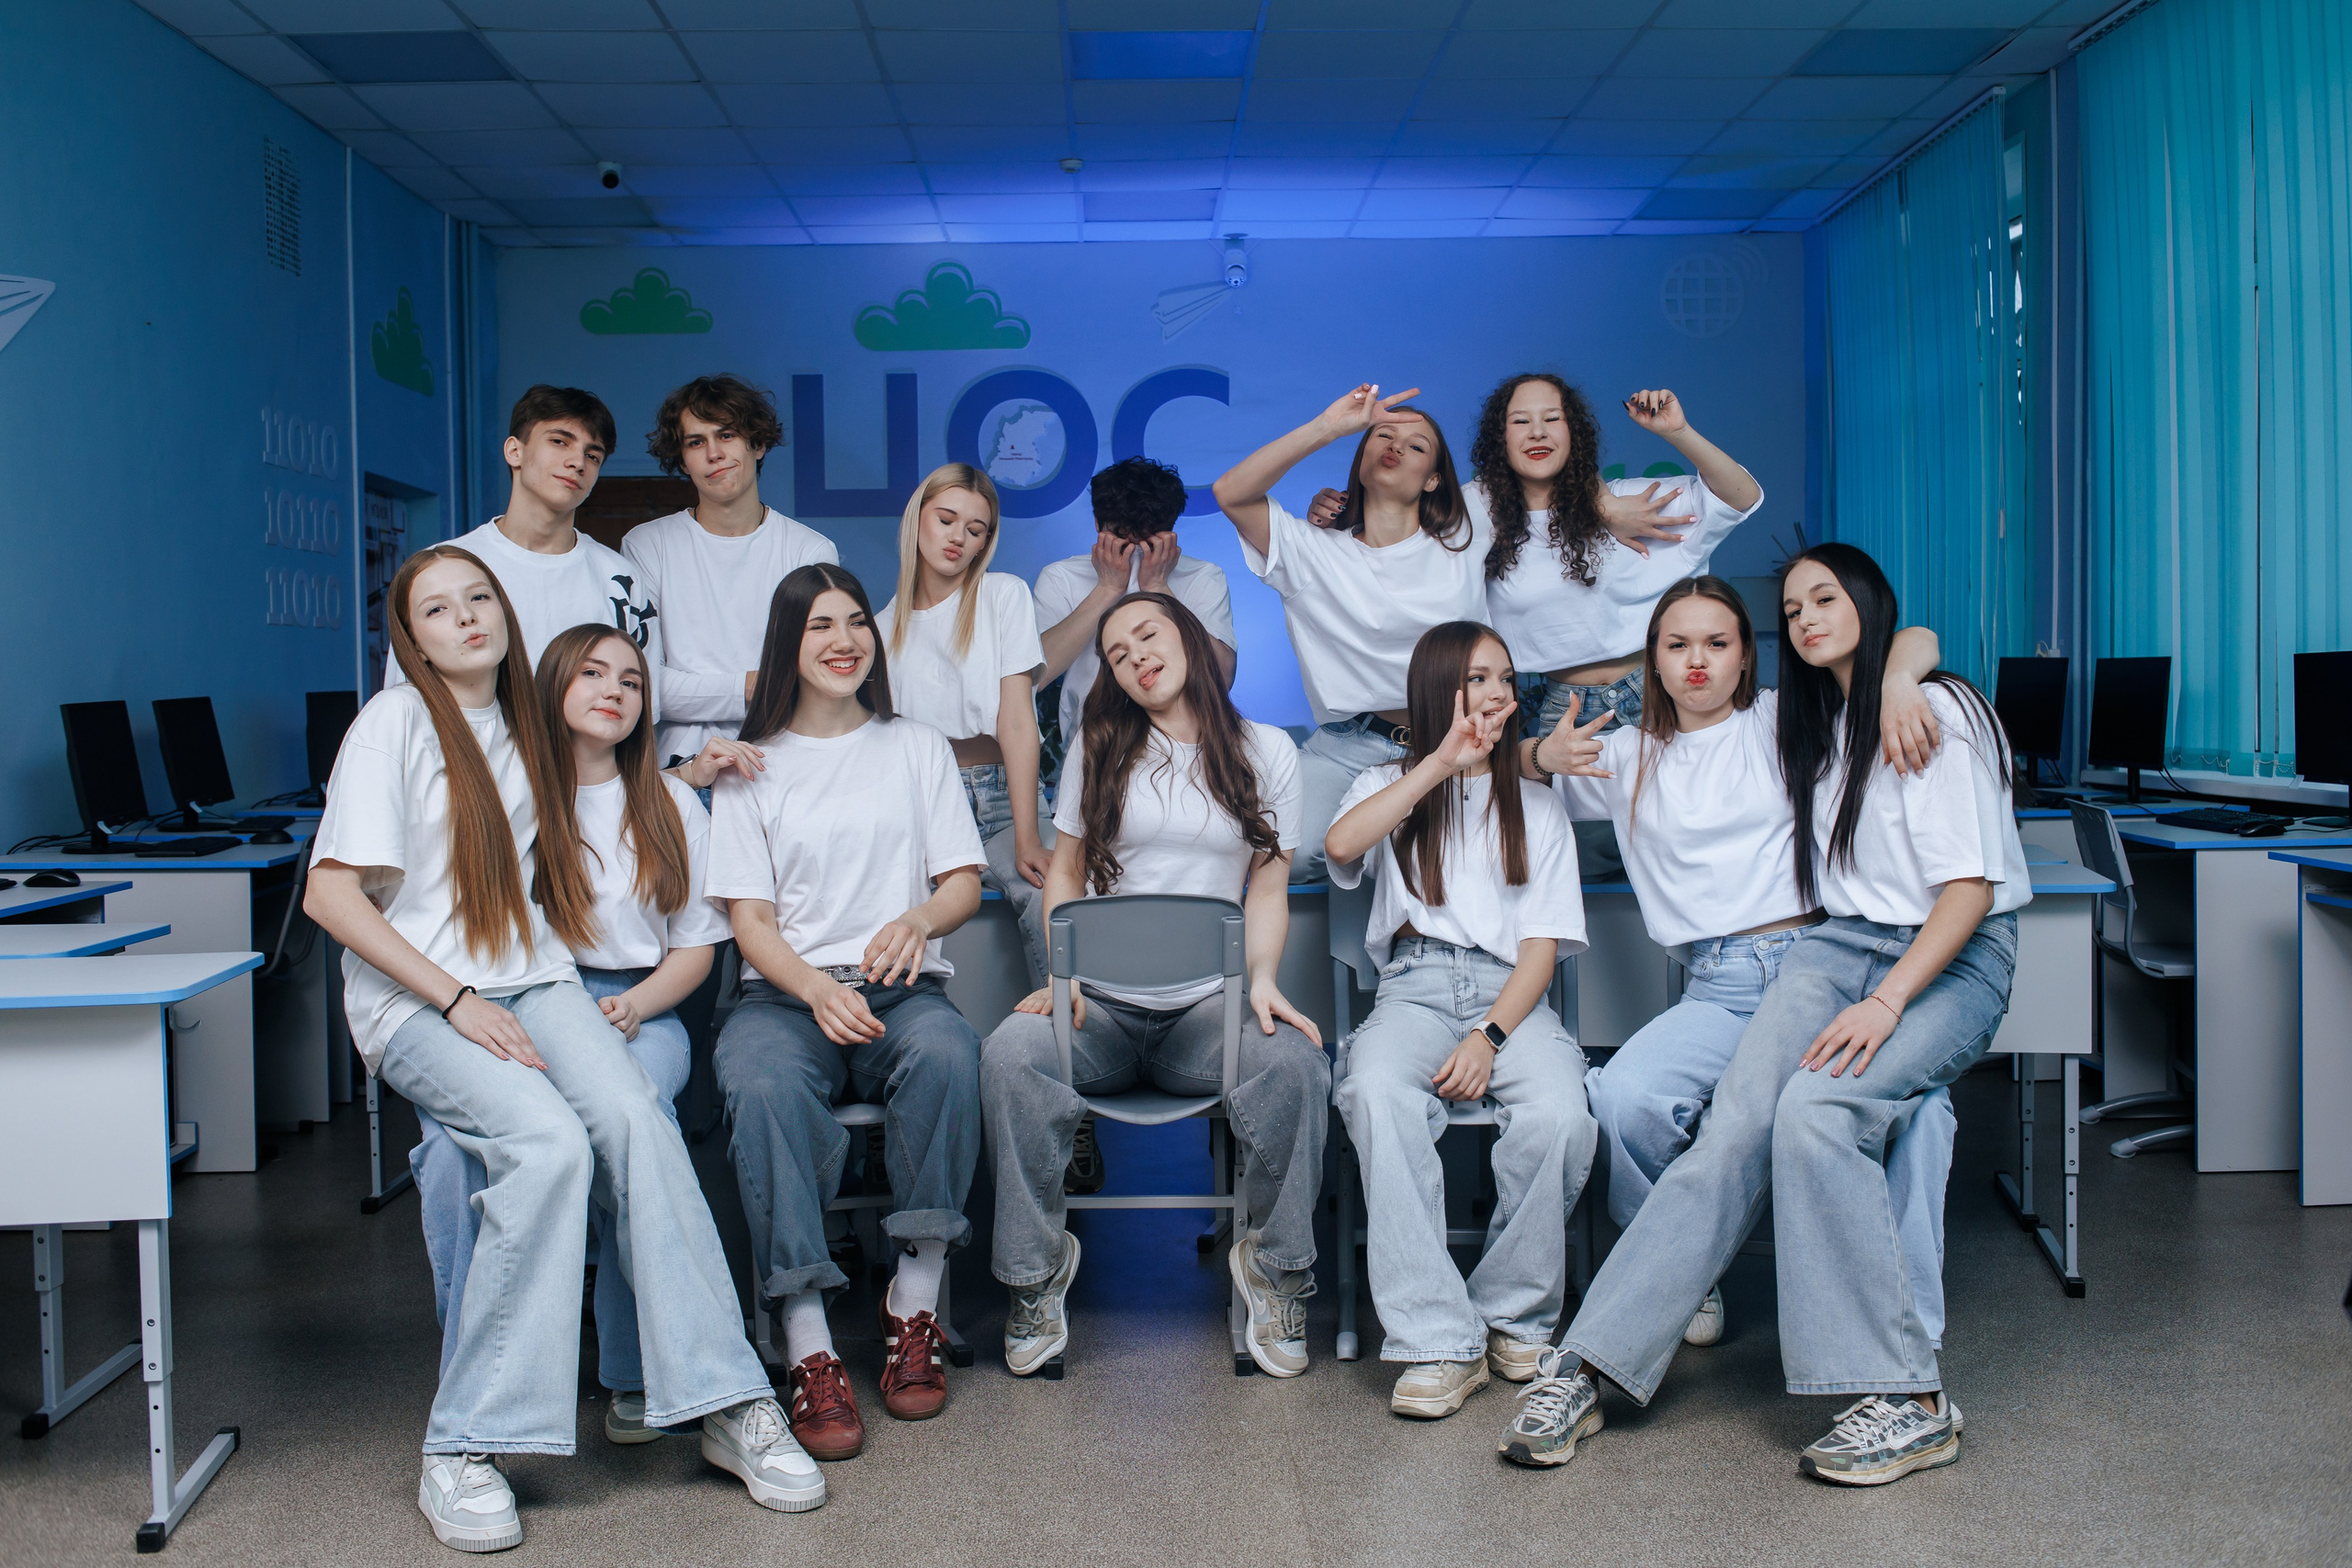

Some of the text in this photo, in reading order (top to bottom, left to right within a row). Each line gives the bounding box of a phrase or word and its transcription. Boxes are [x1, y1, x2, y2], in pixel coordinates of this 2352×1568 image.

[262, 407, 339, 480] 11010
[792, 366, 1229, 519] ЦОС
[264, 488, 341, 557] 10110
[266, 567, 344, 630] 11010
